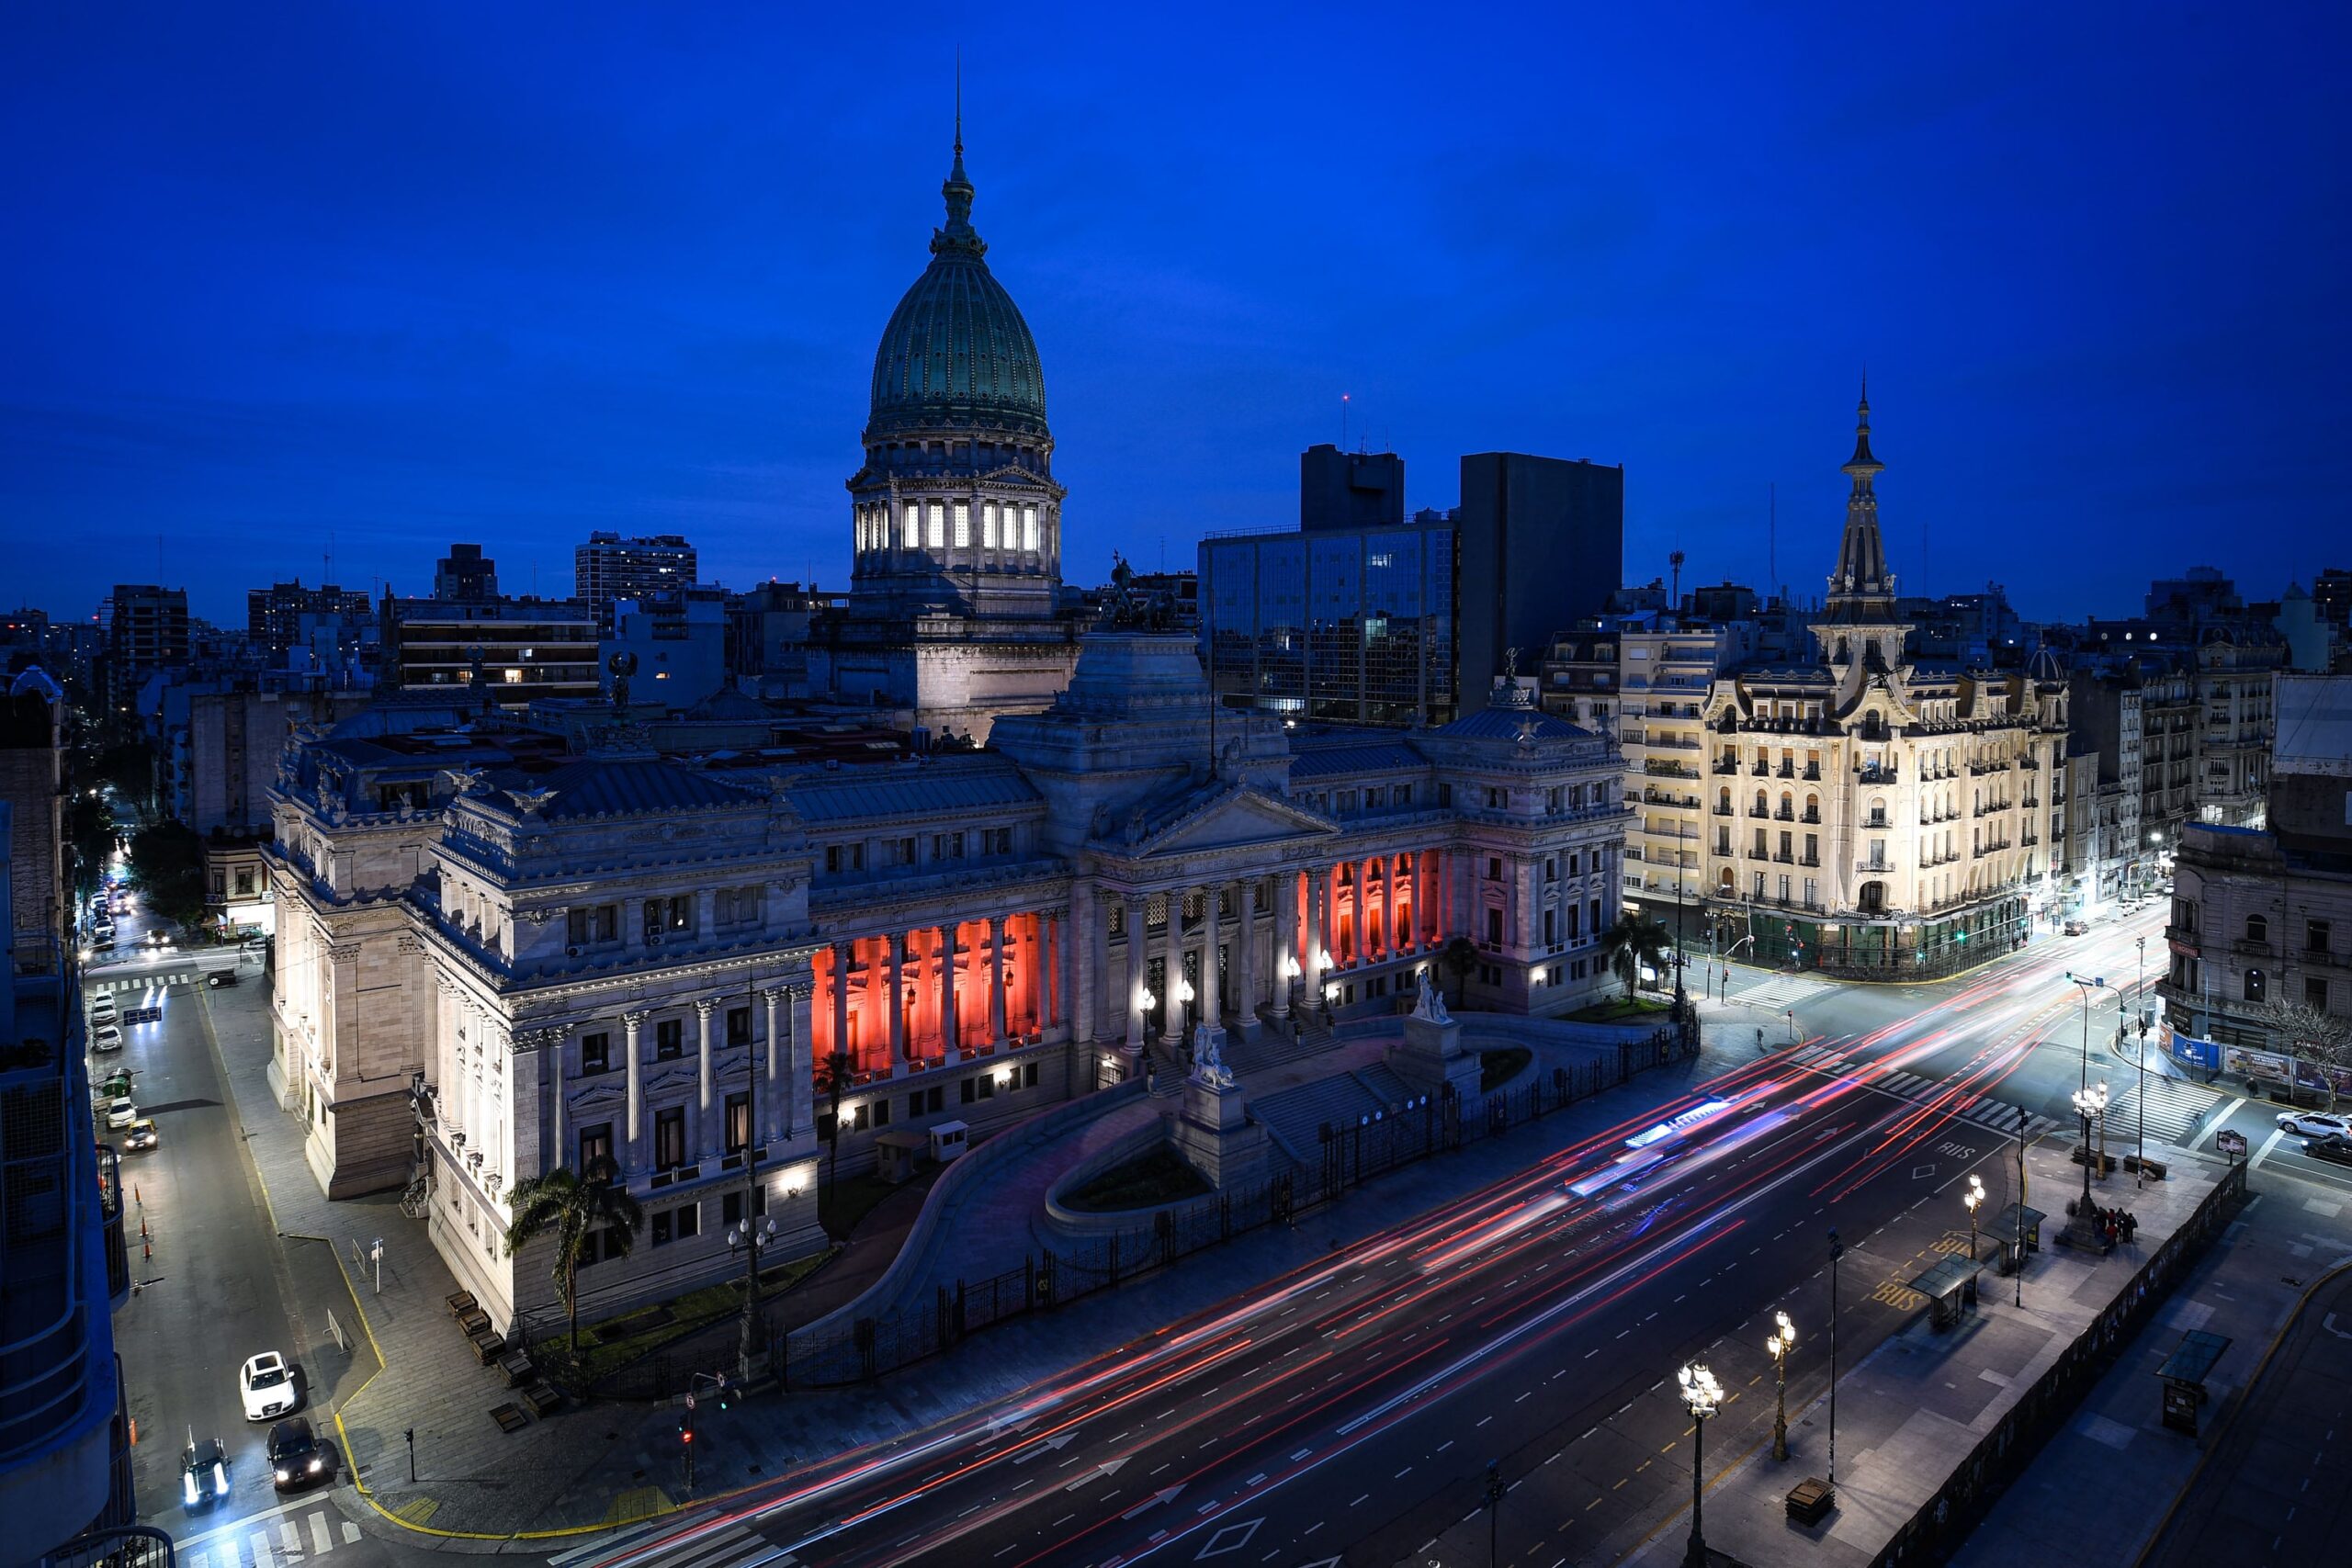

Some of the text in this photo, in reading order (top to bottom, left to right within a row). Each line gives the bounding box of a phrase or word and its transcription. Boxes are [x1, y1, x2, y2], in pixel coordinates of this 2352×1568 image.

[1934, 1142, 1976, 1159] BUS
[1933, 1237, 1973, 1259] BU
[1871, 1283, 1924, 1311] BUS
